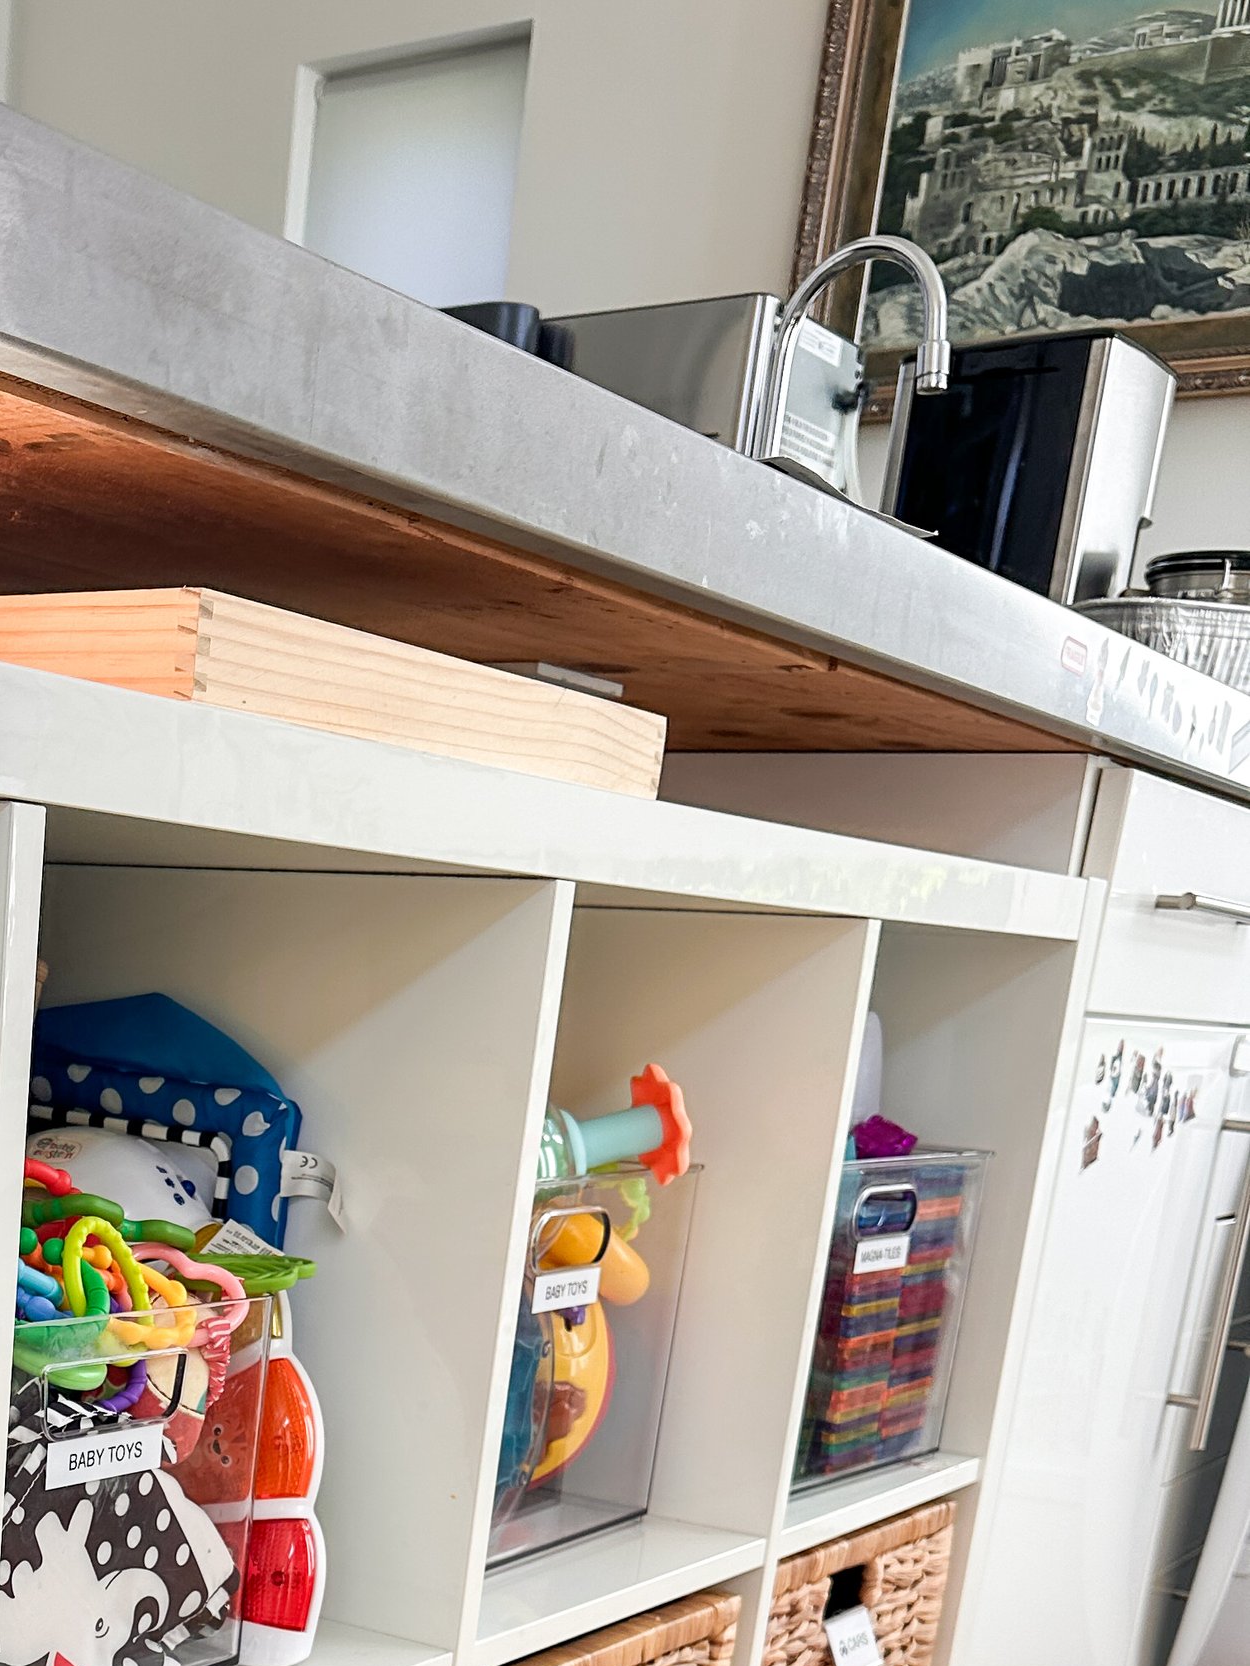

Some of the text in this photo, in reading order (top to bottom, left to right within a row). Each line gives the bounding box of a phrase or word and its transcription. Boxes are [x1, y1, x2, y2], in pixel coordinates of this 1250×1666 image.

[545, 1280, 588, 1300] BABY TOYS
[68, 1441, 143, 1471] BABY TOYS
